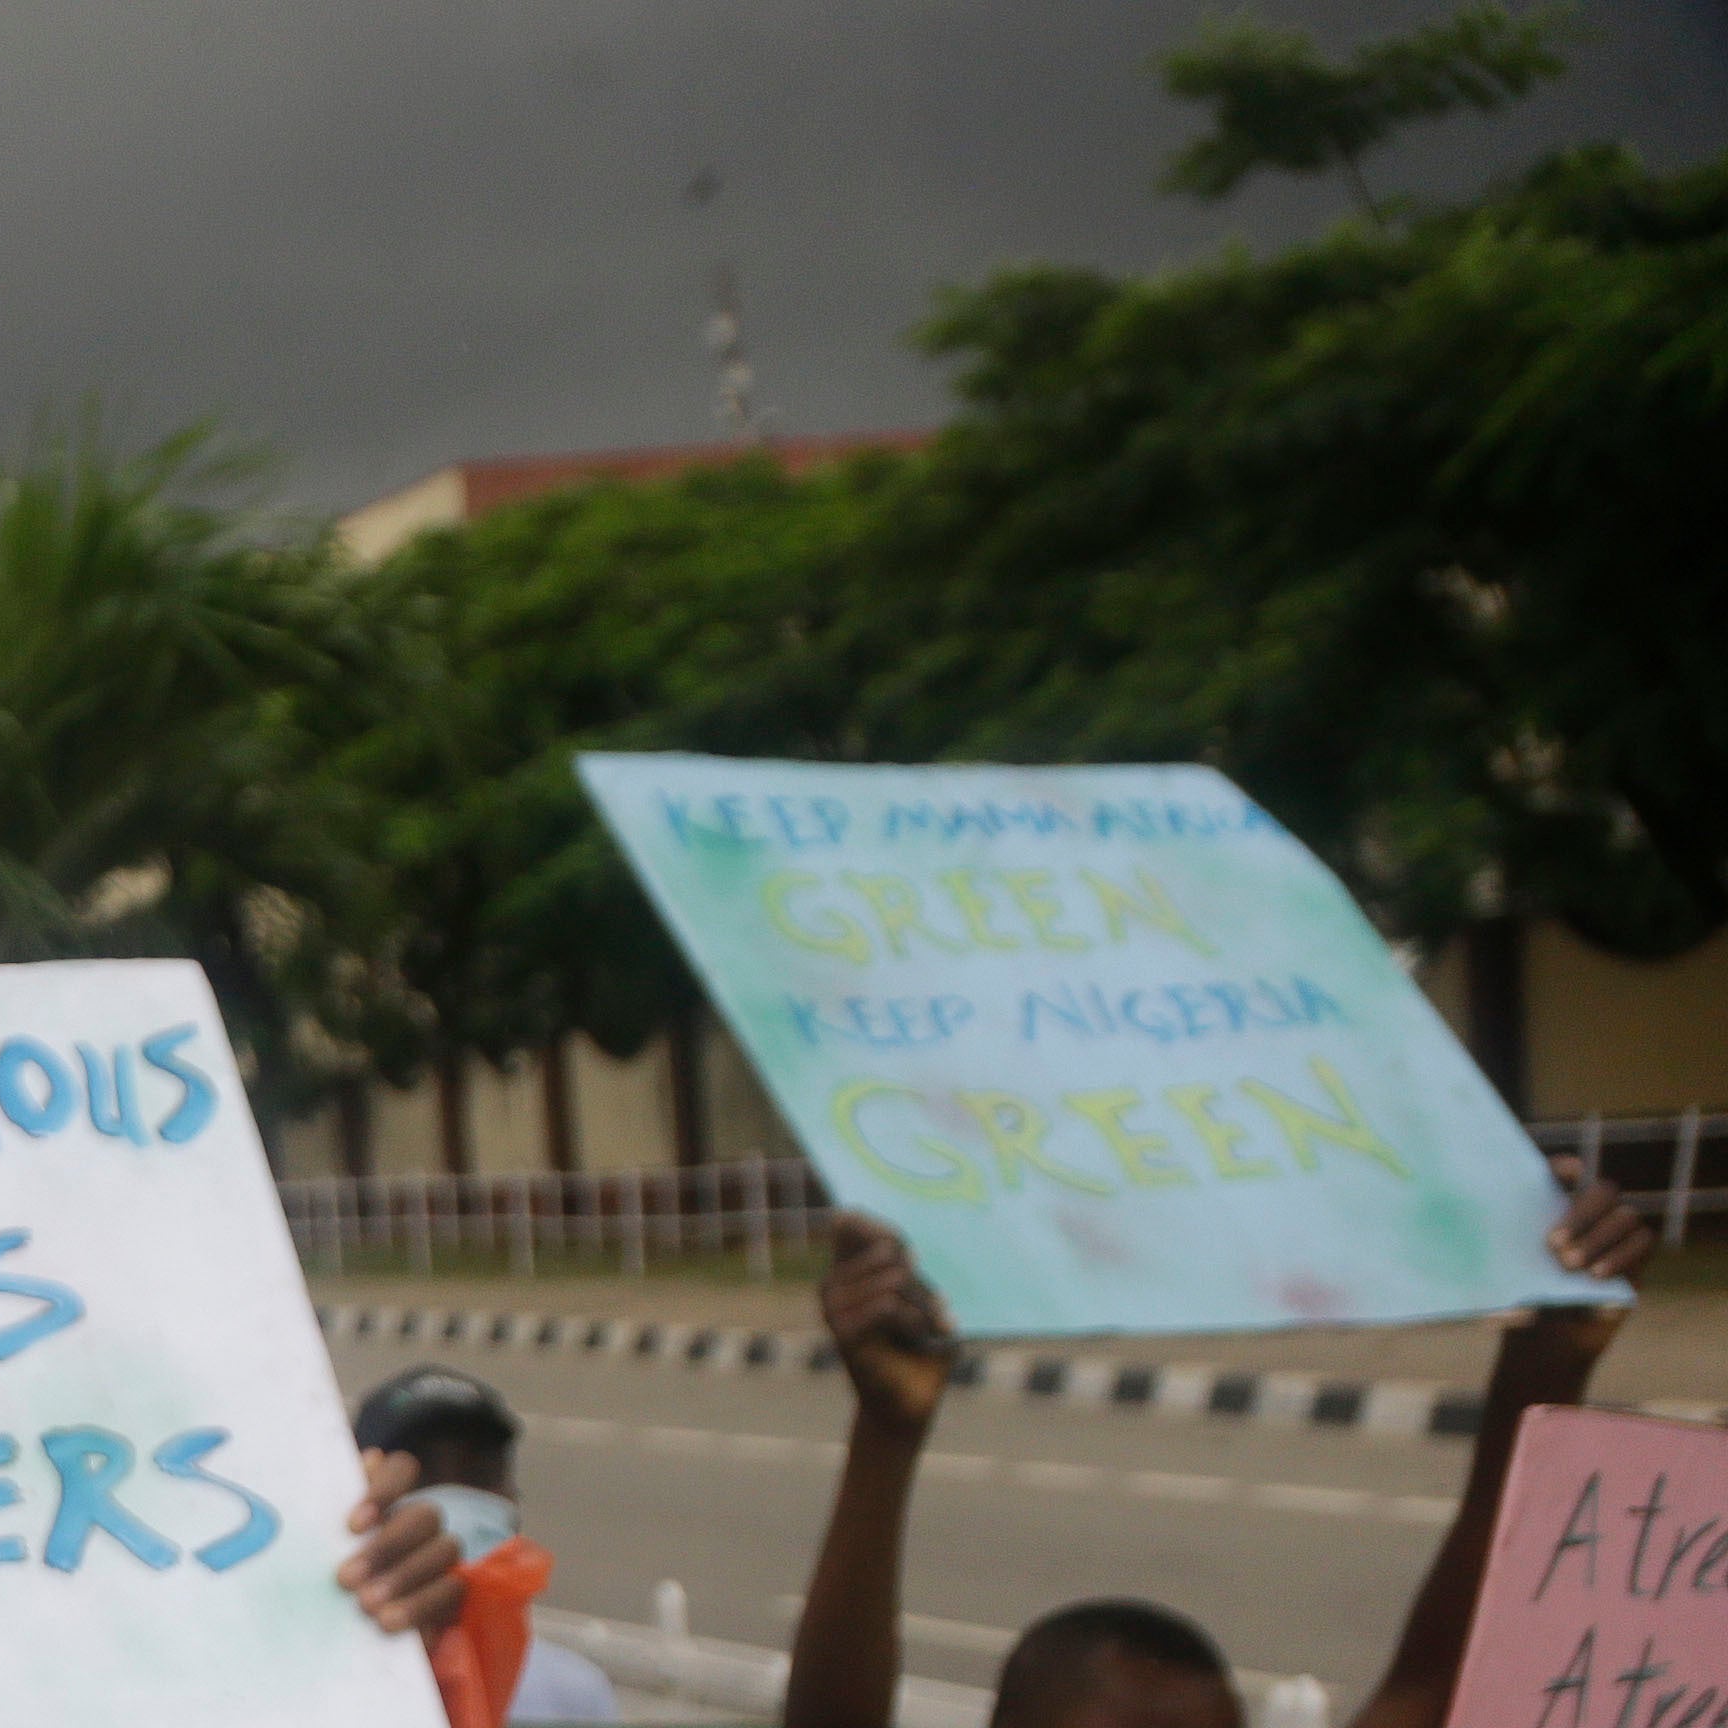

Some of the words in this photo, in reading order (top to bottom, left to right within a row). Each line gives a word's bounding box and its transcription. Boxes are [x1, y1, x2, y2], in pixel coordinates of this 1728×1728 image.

[761, 864, 1221, 966] GREEN
[786, 992, 976, 1050] KEEP
[1020, 974, 1349, 1042] NIGERIA
[832, 1053, 1412, 1206] GREEN
